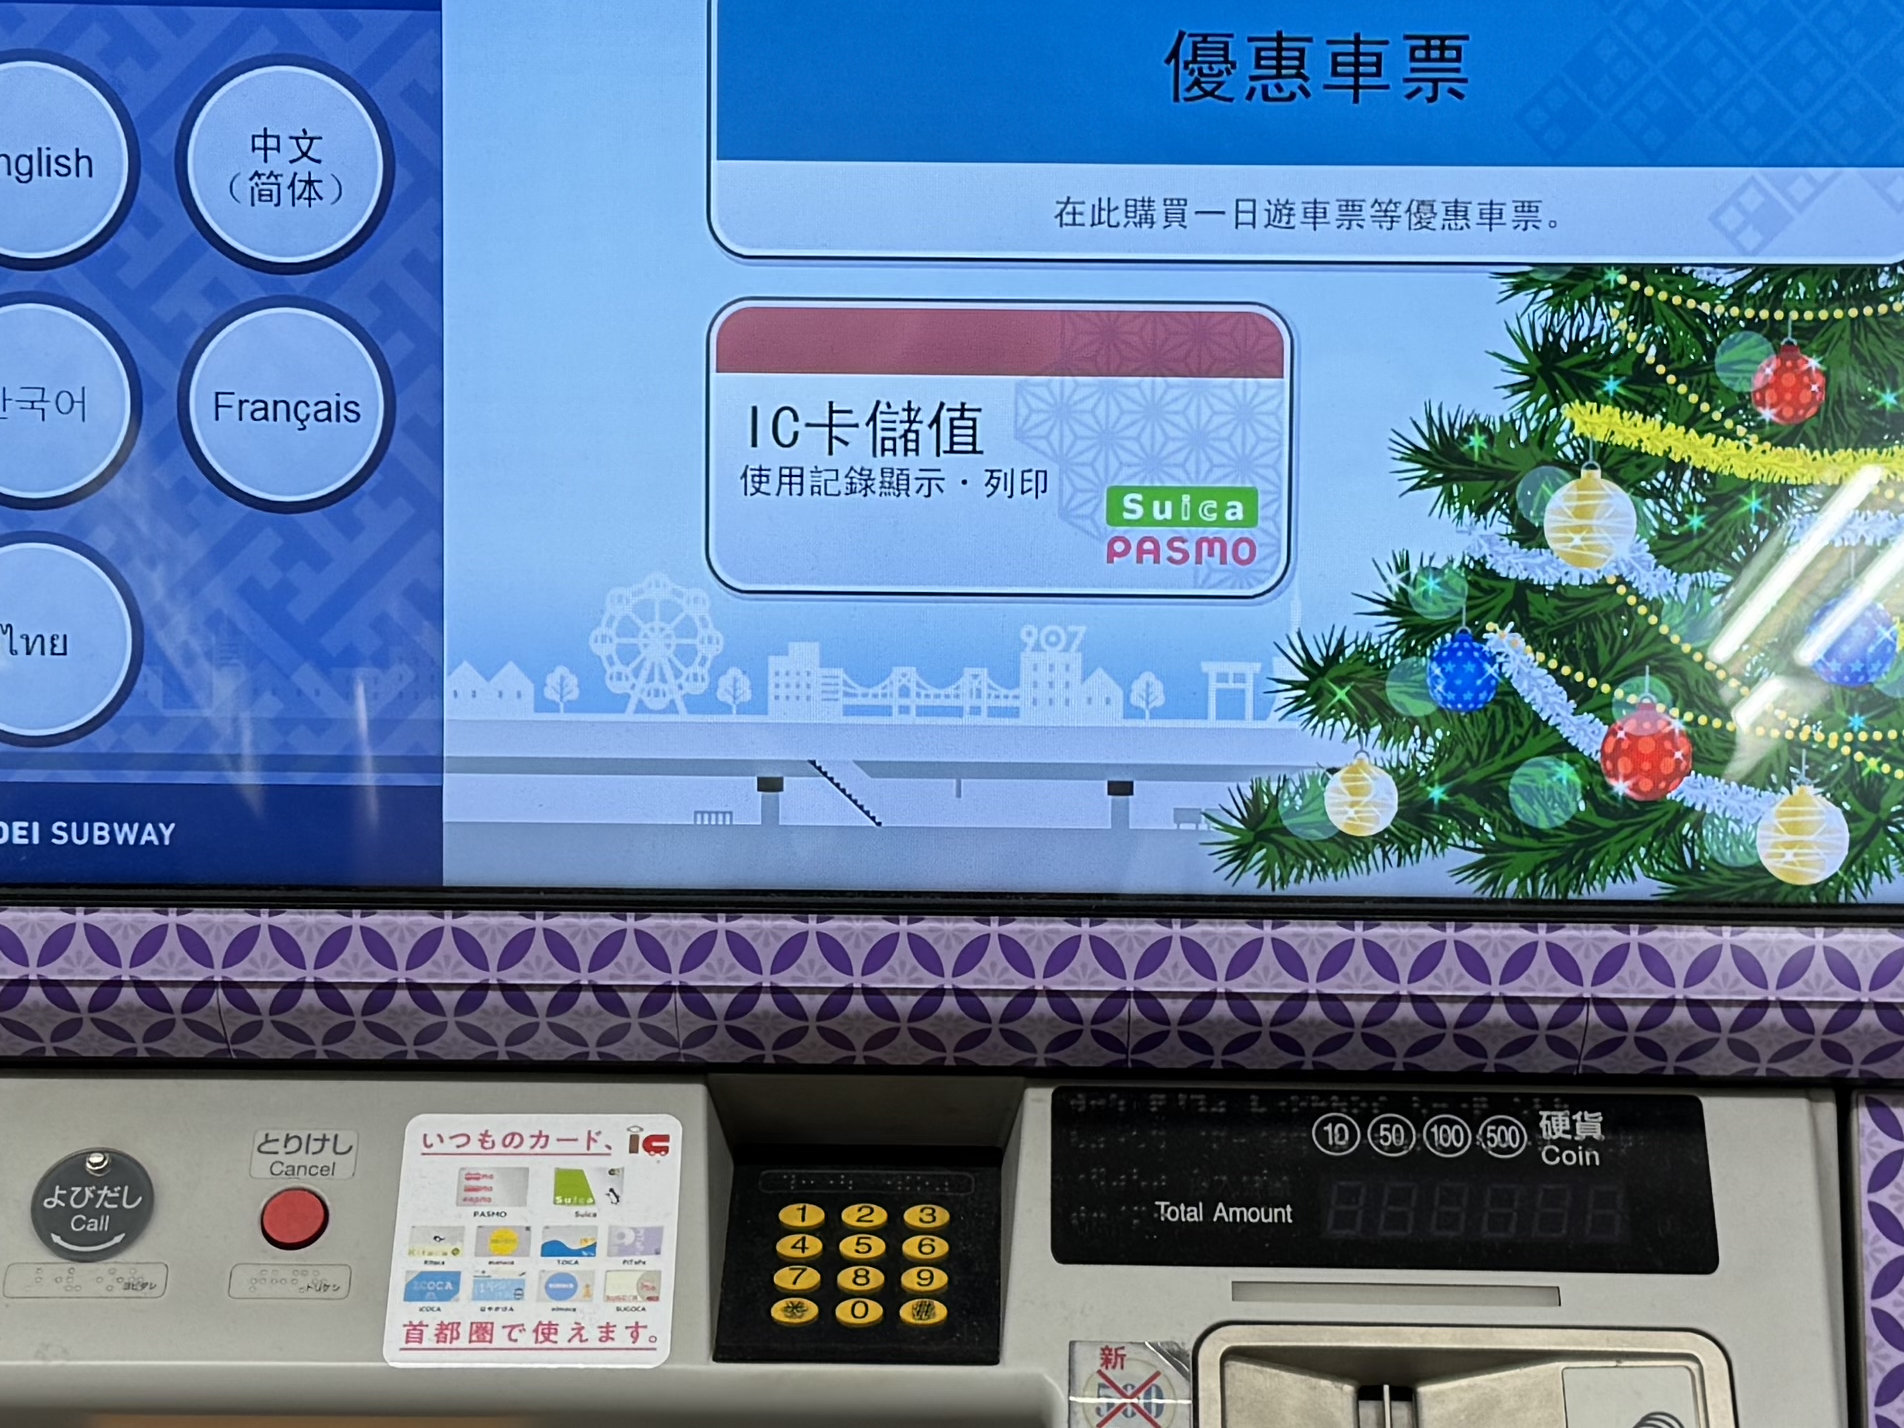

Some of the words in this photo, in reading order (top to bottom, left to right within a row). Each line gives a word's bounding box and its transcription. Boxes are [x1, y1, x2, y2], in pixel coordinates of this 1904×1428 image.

[1164, 29, 1472, 105] 優惠車票
[249, 128, 323, 167] 中文
[1054, 196, 1561, 234] 在此購買一日遊車票等優惠車票。
[213, 390, 362, 431] Français
[748, 400, 985, 458] IC卡儲值
[1121, 493, 1245, 522] Suica
[1106, 535, 1257, 566] PASMO
[0, 622, 68, 656] ไทย
[51, 821, 176, 846] SUBWAY
[1323, 1123, 1349, 1146] 10
[1379, 1124, 1404, 1146] 50
[1430, 1124, 1463, 1148] 100
[1486, 1125, 1521, 1149] 500
[1539, 1110, 1605, 1141] 硬貨
[256, 1132, 353, 1156] とりけし
[422, 1129, 613, 1151] いつものカード、
[1541, 1144, 1600, 1166] Coin
[269, 1160, 336, 1177] Cancel
[43, 1184, 143, 1210] よびだし
[70, 1214, 110, 1232] Call
[473, 1210, 507, 1218] PASMO
[796, 1204, 807, 1223] 1
[856, 1205, 875, 1223] 2
[919, 1206, 937, 1224] 3
[1155, 1200, 1203, 1222] Total
[1213, 1201, 1294, 1223] Amount
[790, 1235, 809, 1254] 4
[854, 1236, 872, 1254] 5
[917, 1237, 936, 1255] 6
[788, 1267, 808, 1286] 7
[852, 1268, 870, 1287] 8
[916, 1268, 934, 1287] 9
[851, 1300, 869, 1319] 0
[403, 1320, 657, 1345] 首都圏で使えます。
[1100, 1345, 1127, 1370] 新
